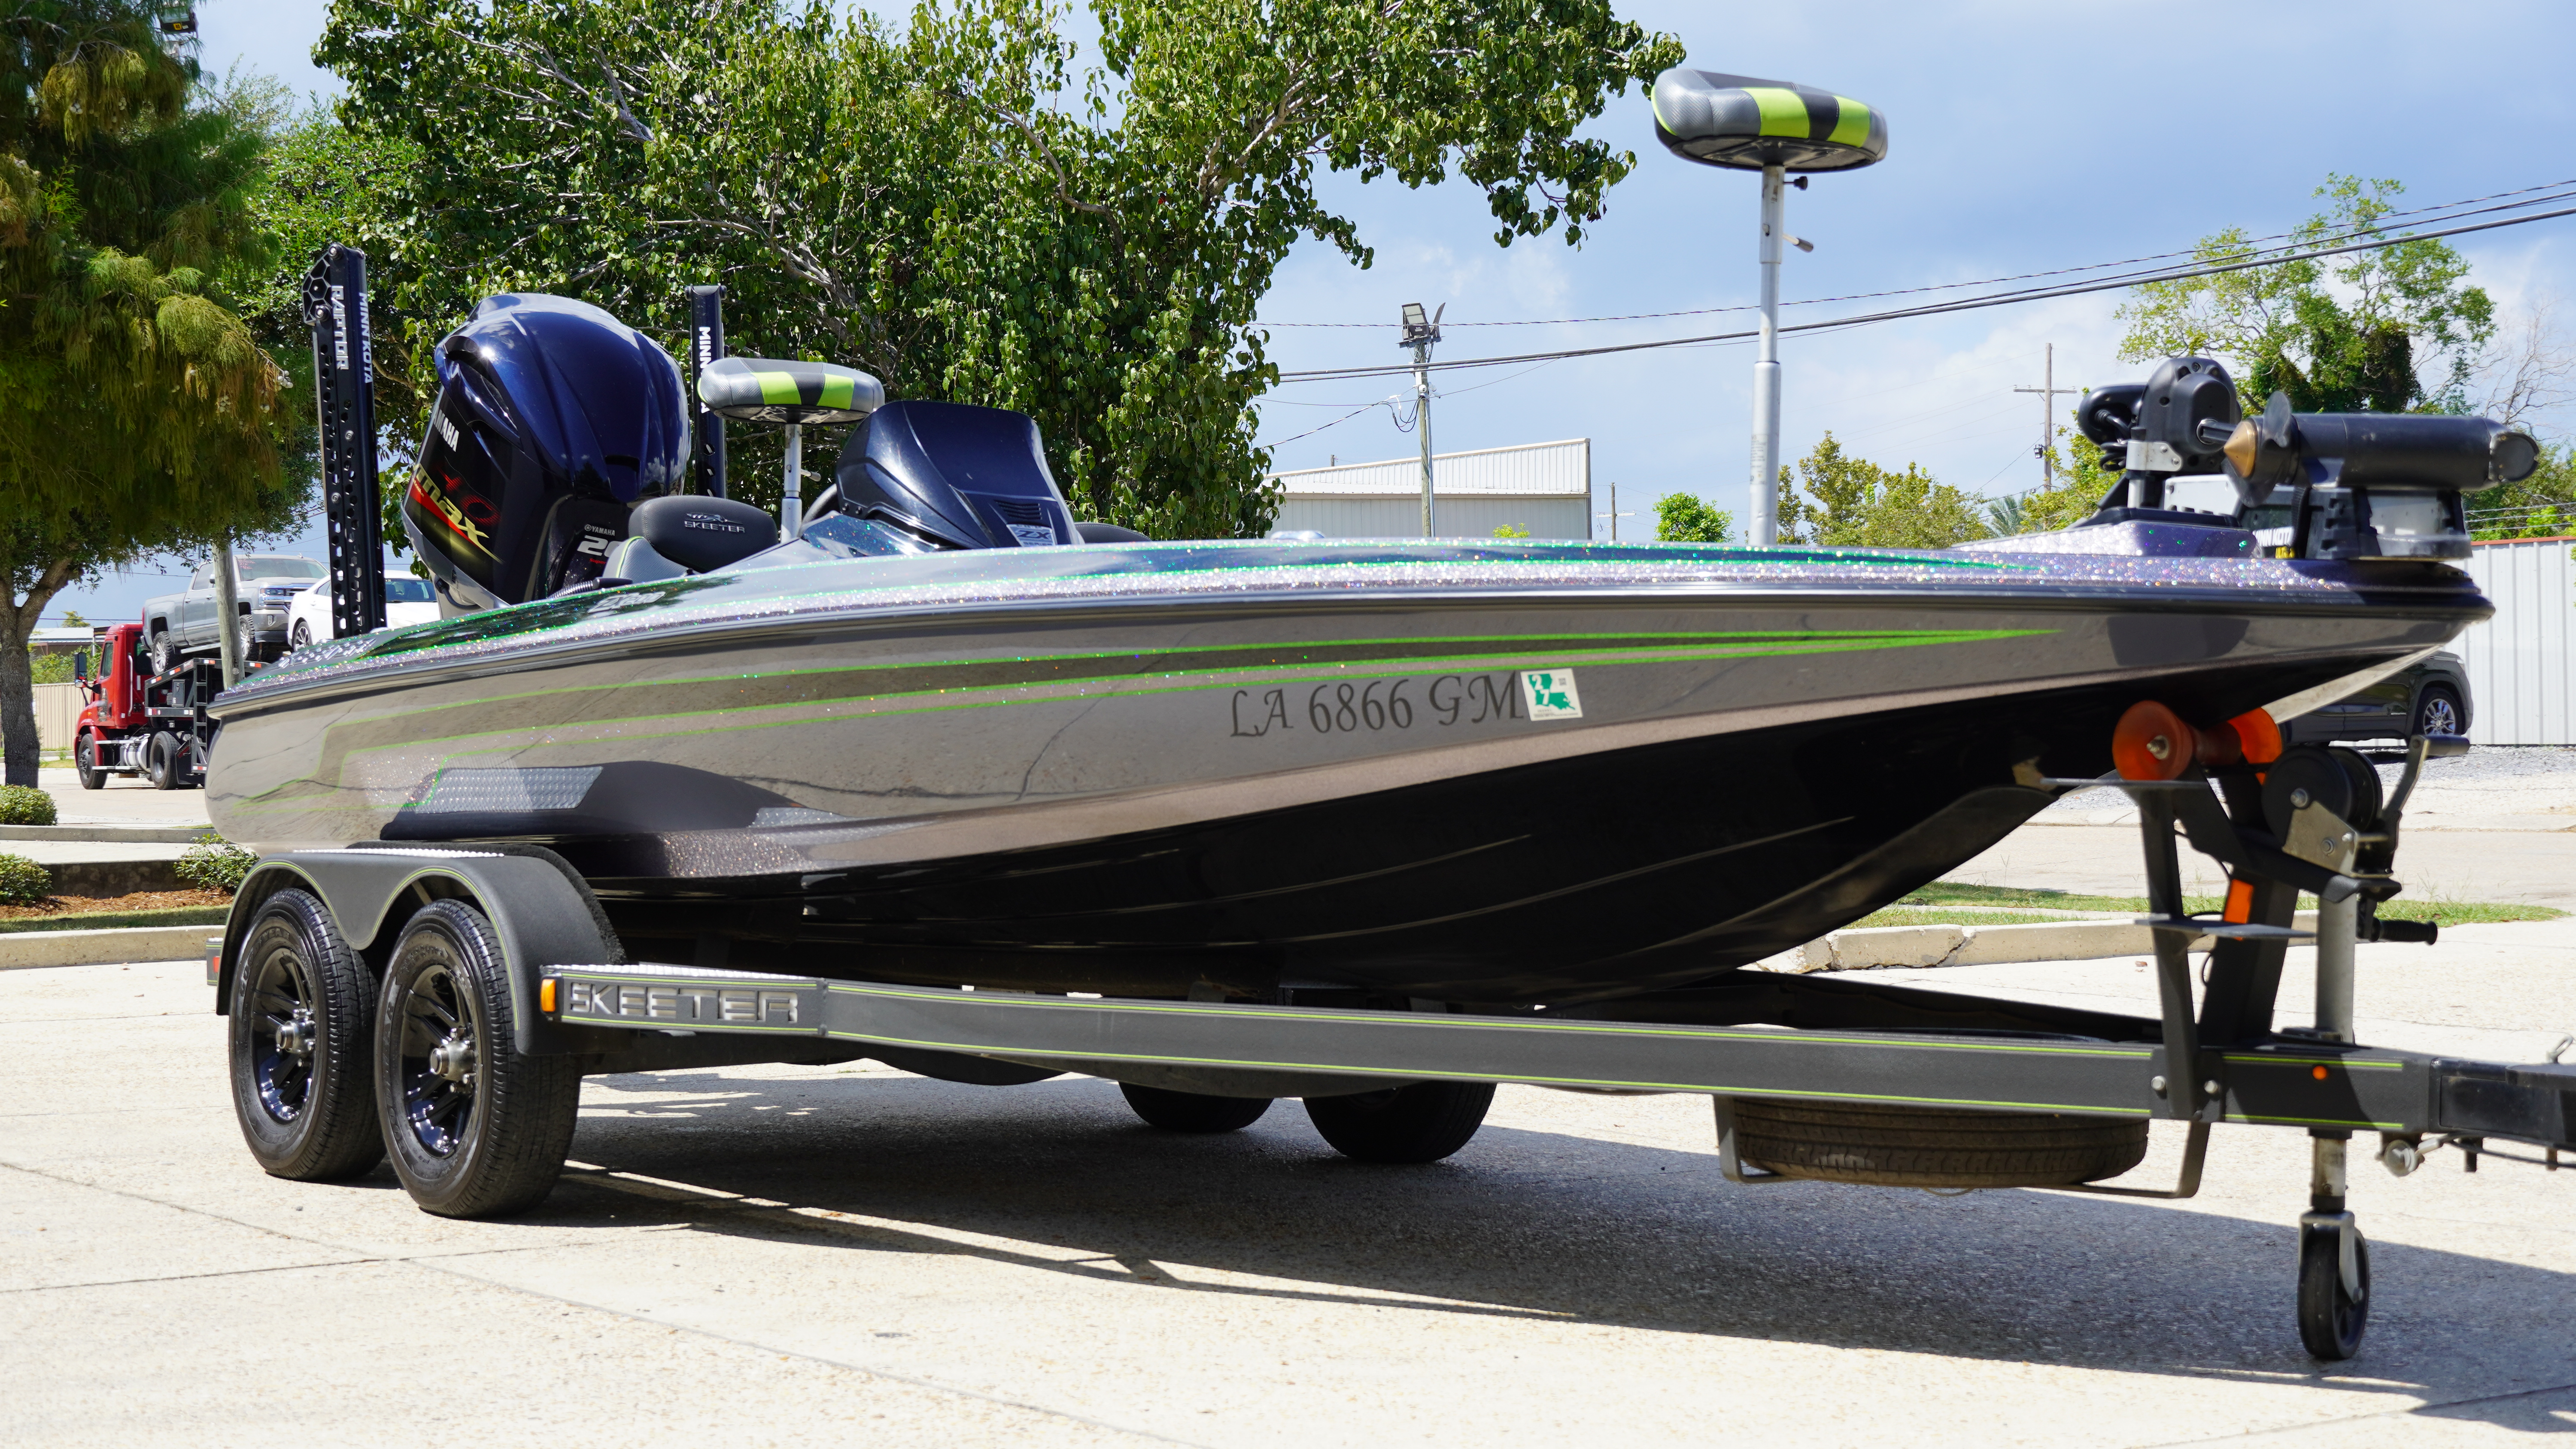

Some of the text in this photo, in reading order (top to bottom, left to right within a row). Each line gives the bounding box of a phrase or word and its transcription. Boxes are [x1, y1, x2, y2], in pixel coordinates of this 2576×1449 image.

[331, 285, 349, 370] RAPTOR
[358, 292, 373, 384] MINN KOTA
[592, 525, 615, 537] YAMAHA
[684, 520, 745, 534] SKEETER
[1016, 529, 1052, 540] ZX
[1230, 671, 1524, 737] LA 6866 GM
[571, 982, 798, 1023] SKEETER
